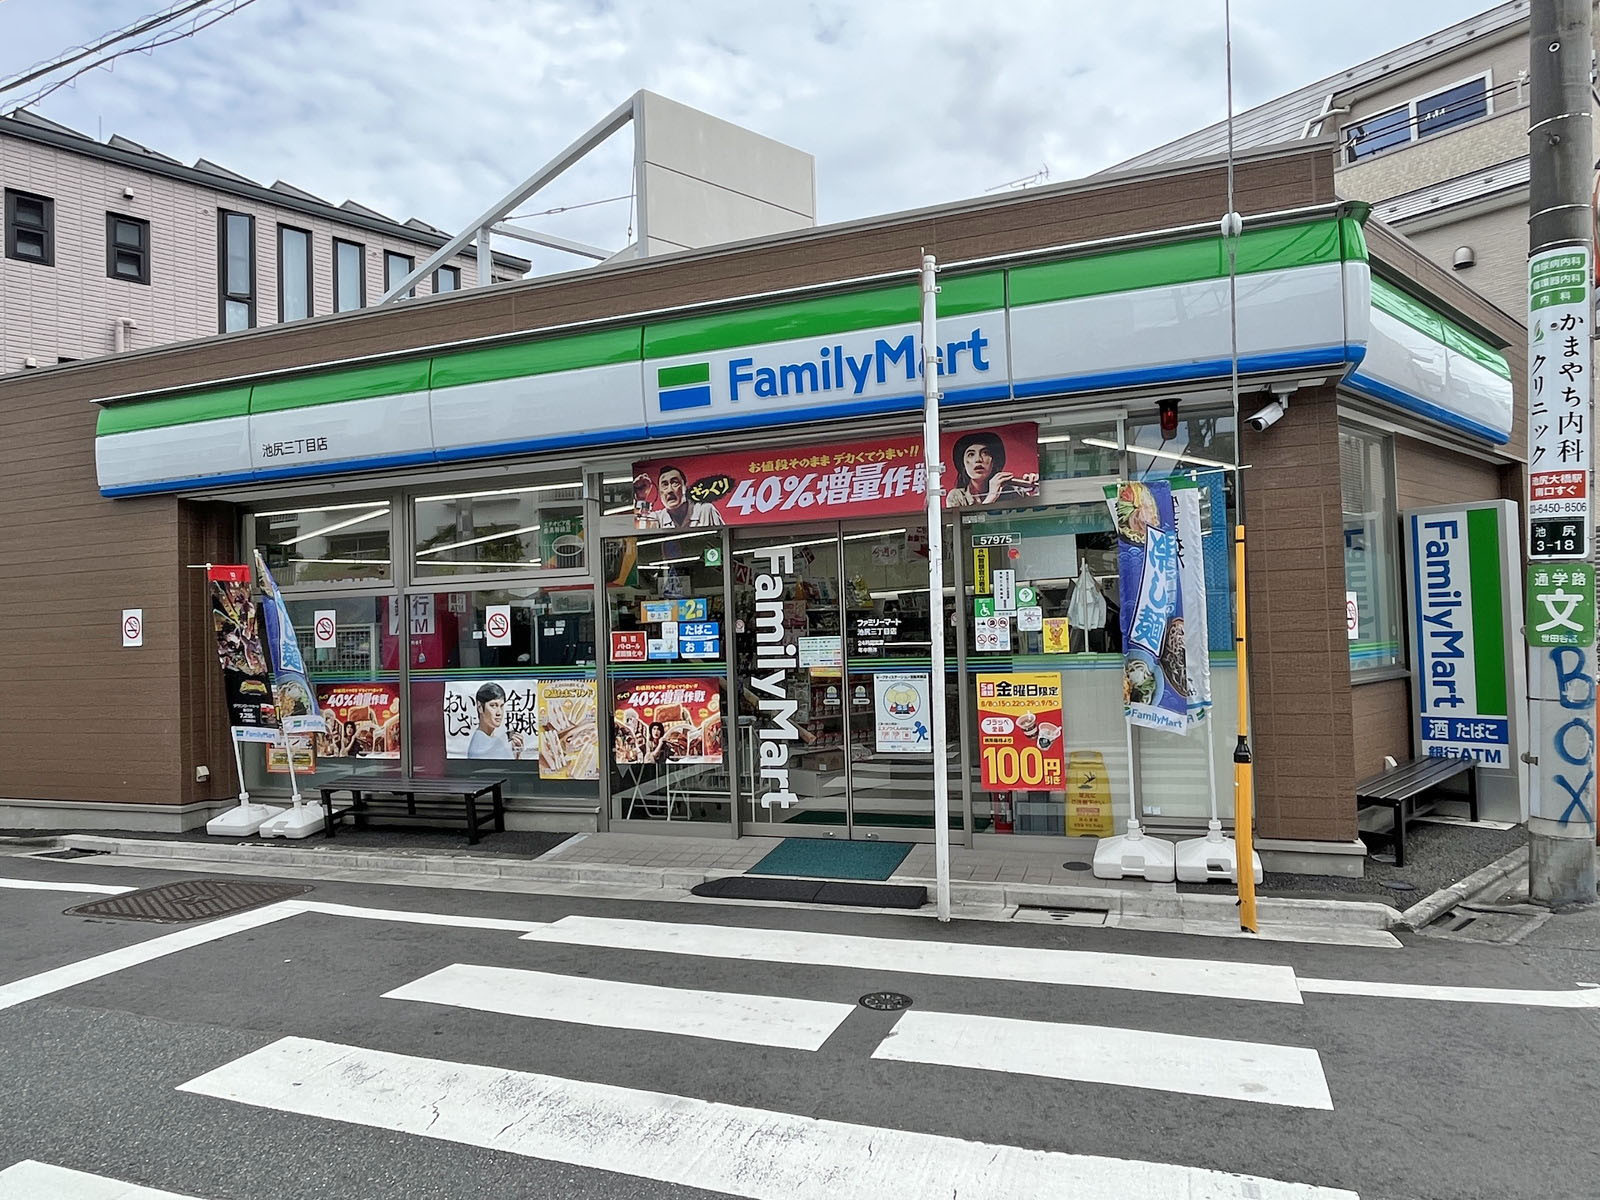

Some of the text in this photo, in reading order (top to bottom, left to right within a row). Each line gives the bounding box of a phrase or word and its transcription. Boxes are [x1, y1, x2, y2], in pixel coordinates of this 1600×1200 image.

[1540, 291, 1571, 304] 内科
[1557, 313, 1584, 463] かまやち内科
[1531, 354, 1549, 467] クリニック
[262, 437, 328, 458] 池尻三丁目店
[749, 455, 830, 473] お値段そのまま
[689, 478, 731, 500] ざっくり
[1531, 473, 1583, 486] 池尻大橋駅
[1535, 485, 1578, 497] 南口すぐ
[980, 535, 1013, 545] 57975
[1536, 540, 1575, 551] 3-18
[1534, 572, 1586, 586] 通学路
[1134, 530, 1168, 651] 冷し麺
[1424, 519, 1466, 708] FamilyMart
[1535, 588, 1584, 632] 文
[685, 624, 713, 635] たばこ
[856, 618, 902, 627] ファミリーマート
[857, 627, 897, 636] 池尻三丁目店
[1541, 634, 1578, 643] 世田谷区
[751, 547, 799, 809] FamilyMart
[995, 681, 1059, 697] 金曜日限定
[443, 688, 536, 713] おい 全力
[505, 712, 539, 737] 投球
[1131, 707, 1182, 729] FamilyMart
[1429, 720, 1499, 739] 酒 たばこ
[1428, 745, 1502, 764] 銀行ATM
